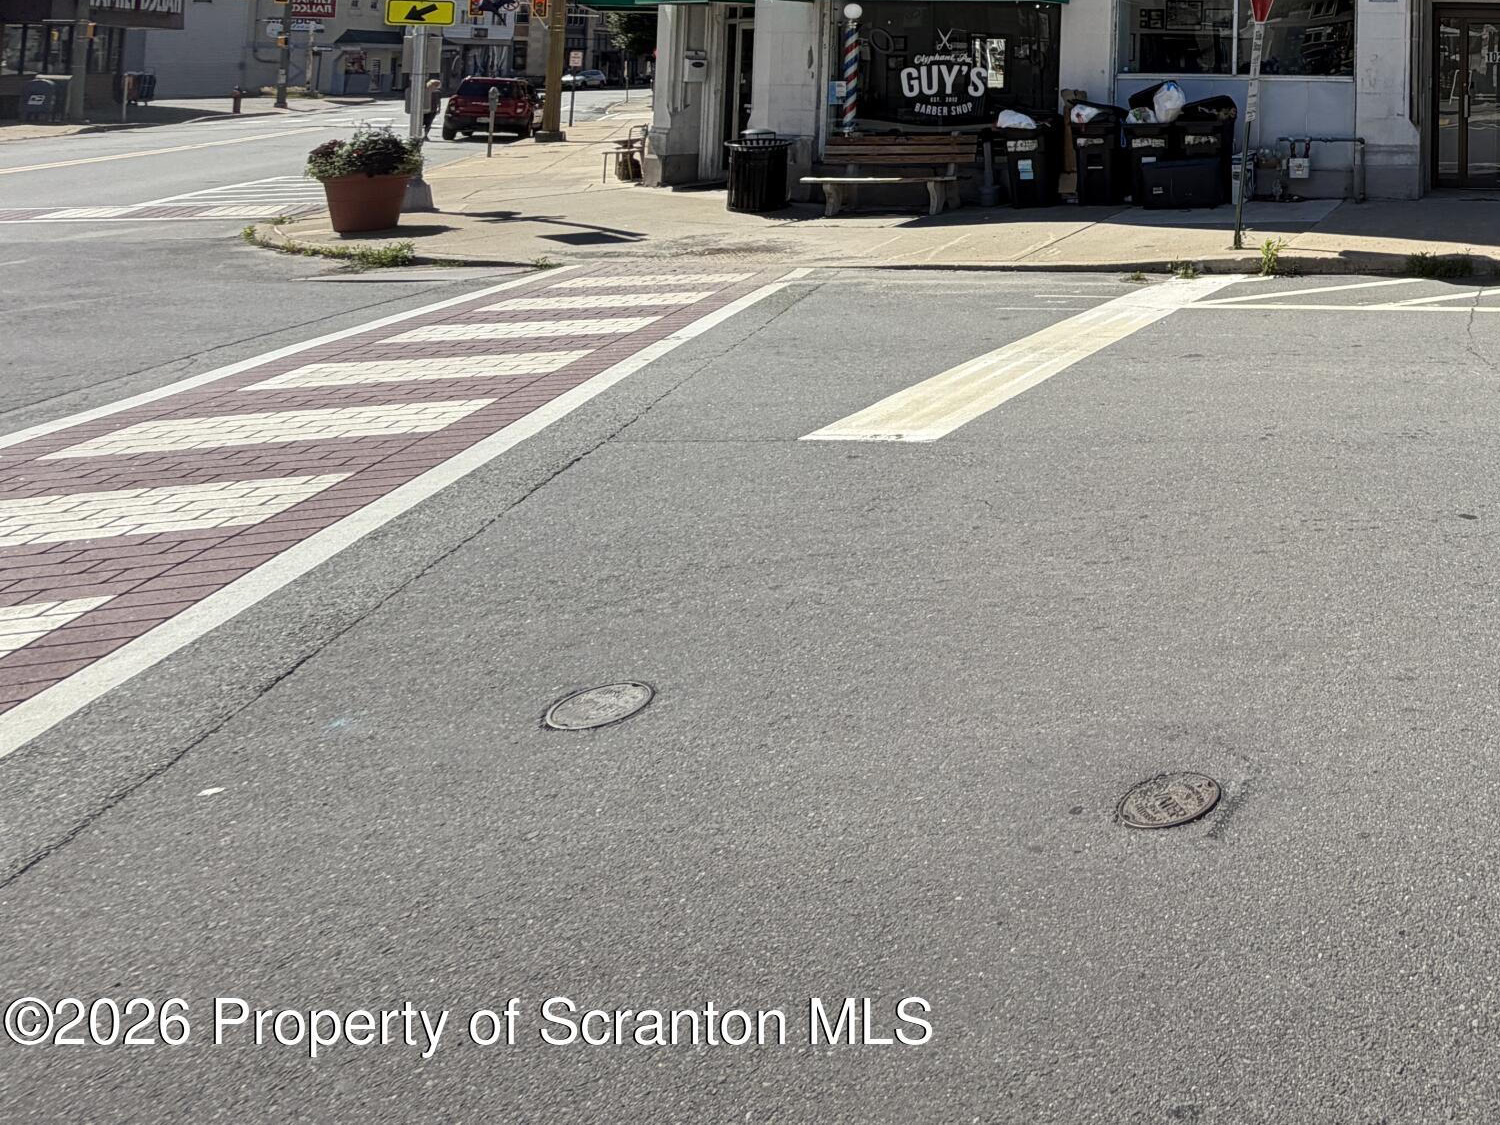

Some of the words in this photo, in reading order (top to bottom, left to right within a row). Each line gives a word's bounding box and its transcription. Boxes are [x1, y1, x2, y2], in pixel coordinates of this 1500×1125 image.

[292, 4, 332, 13] DOLLAR
[900, 65, 987, 98] GUY'S
[914, 102, 948, 116] BARBER
[951, 102, 973, 116] SHOP
